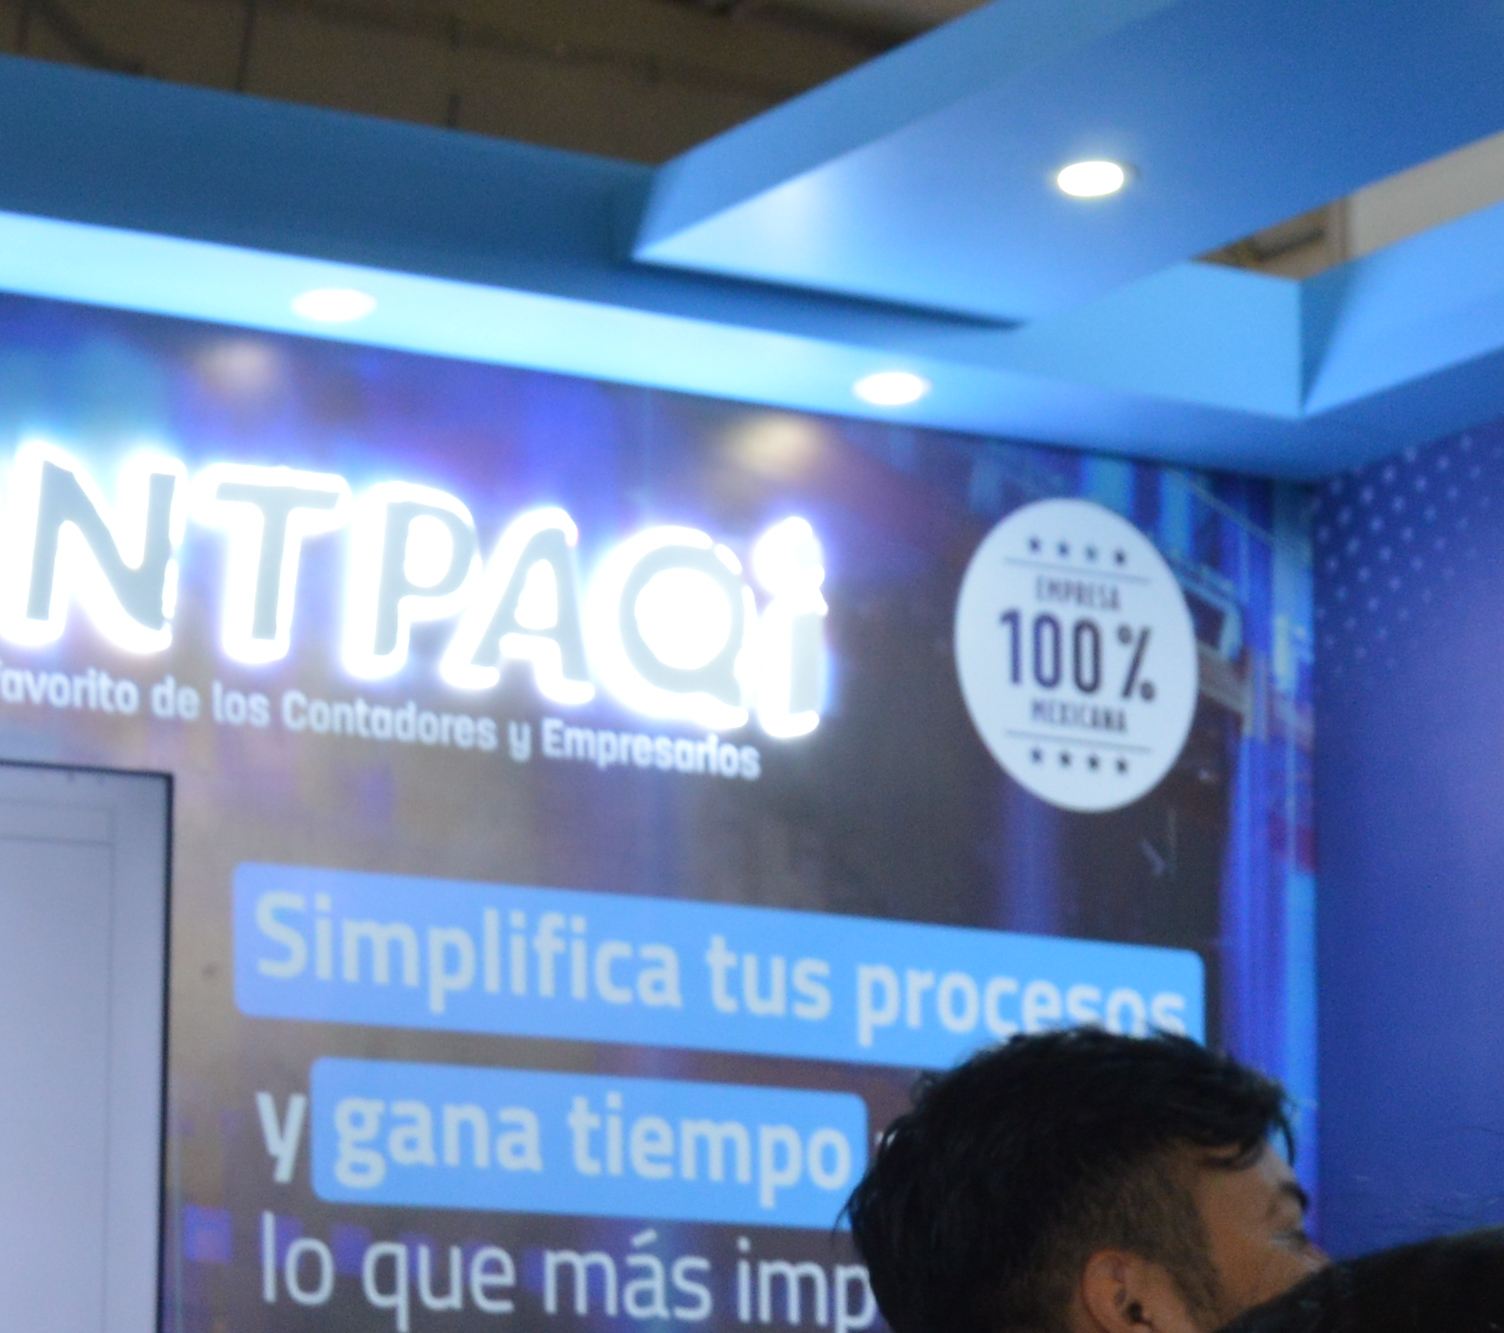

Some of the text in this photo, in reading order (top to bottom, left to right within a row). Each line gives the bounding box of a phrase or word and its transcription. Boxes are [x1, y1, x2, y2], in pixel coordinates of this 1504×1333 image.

[1033, 574, 1122, 613] EMPRESA
[151, 678, 201, 719] de
[212, 680, 270, 727] los
[282, 691, 496, 752] Contadores
[509, 718, 532, 760] y
[542, 719, 760, 779] Empresarios
[1028, 696, 1128, 735] MEXICANA
[254, 892, 1187, 1046] Simplifica tus procesos
[257, 1089, 852, 1203] y gana tiempo
[260, 1211, 334, 1305] lo
[364, 1236, 513, 1333] que
[543, 1232, 712, 1320] más
